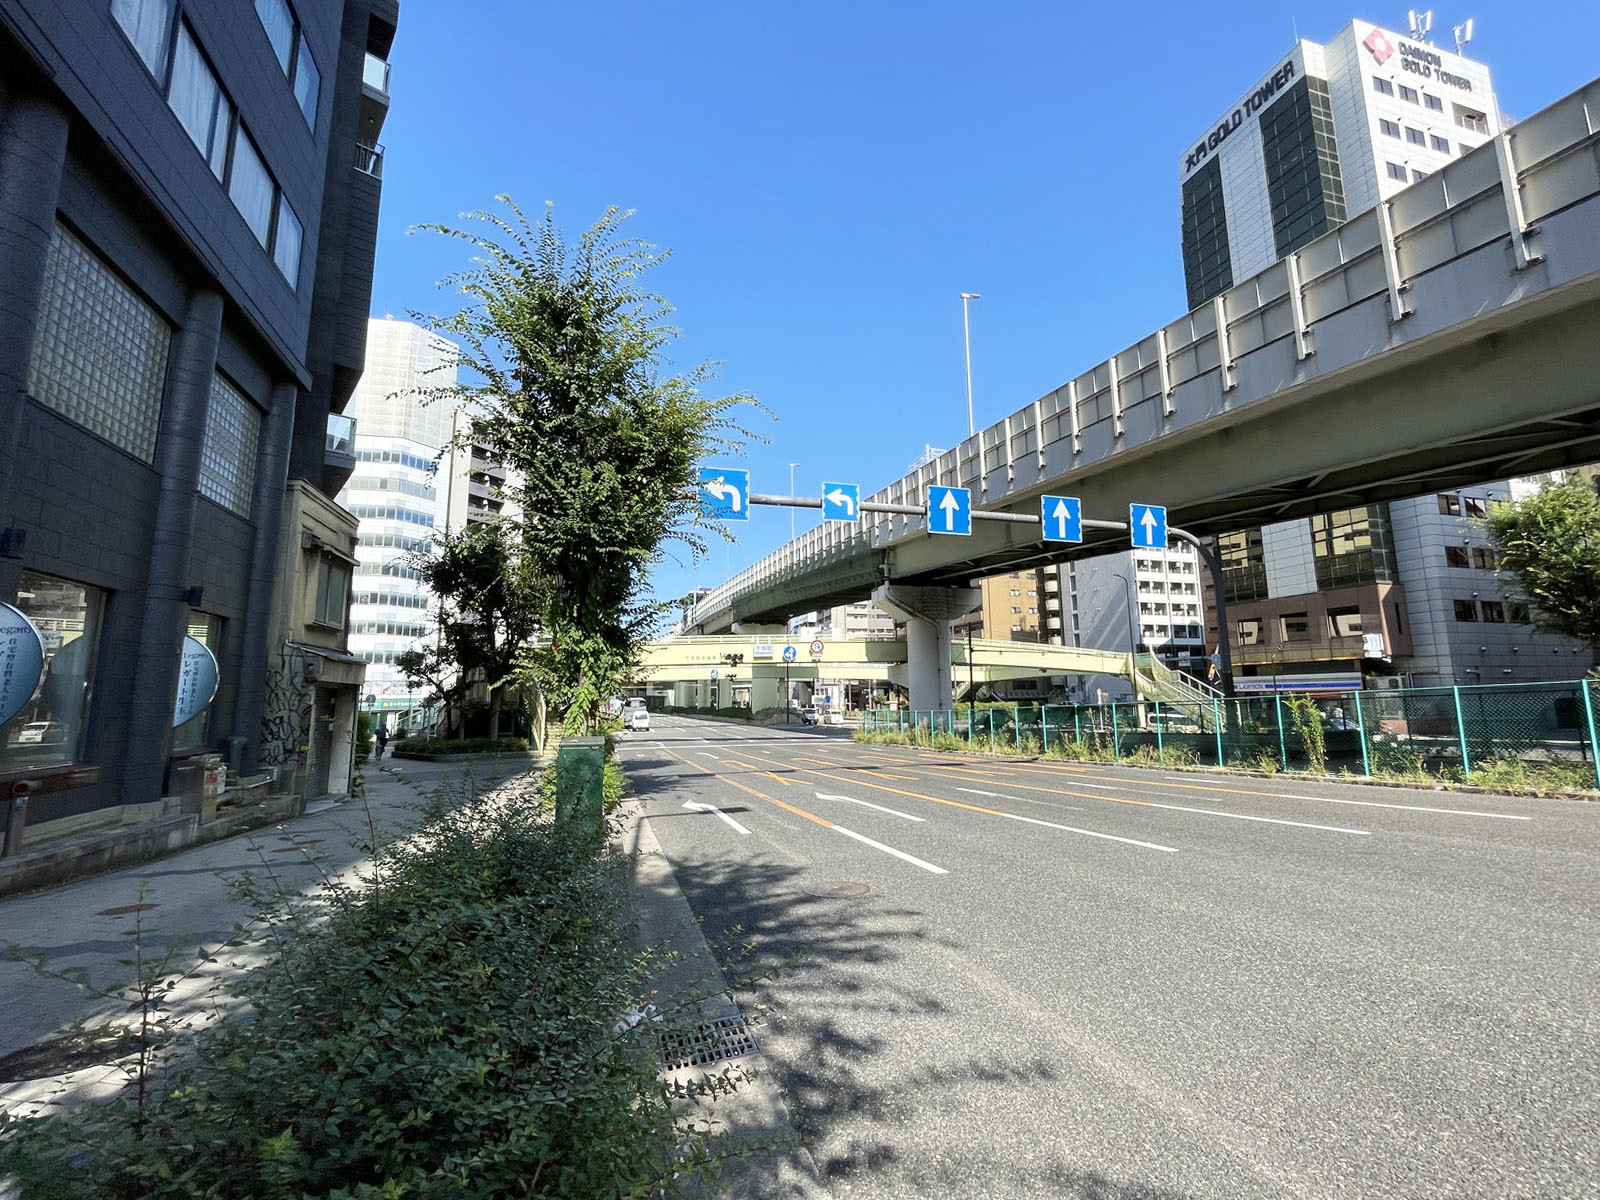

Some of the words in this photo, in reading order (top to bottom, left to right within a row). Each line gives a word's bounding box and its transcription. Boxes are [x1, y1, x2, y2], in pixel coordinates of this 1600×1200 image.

[1399, 42, 1441, 68] DAIMON
[1401, 57, 1431, 79] GOLD
[1434, 69, 1472, 92] TOWER
[1208, 109, 1243, 151] GOLD
[1243, 60, 1295, 118] TOWER
